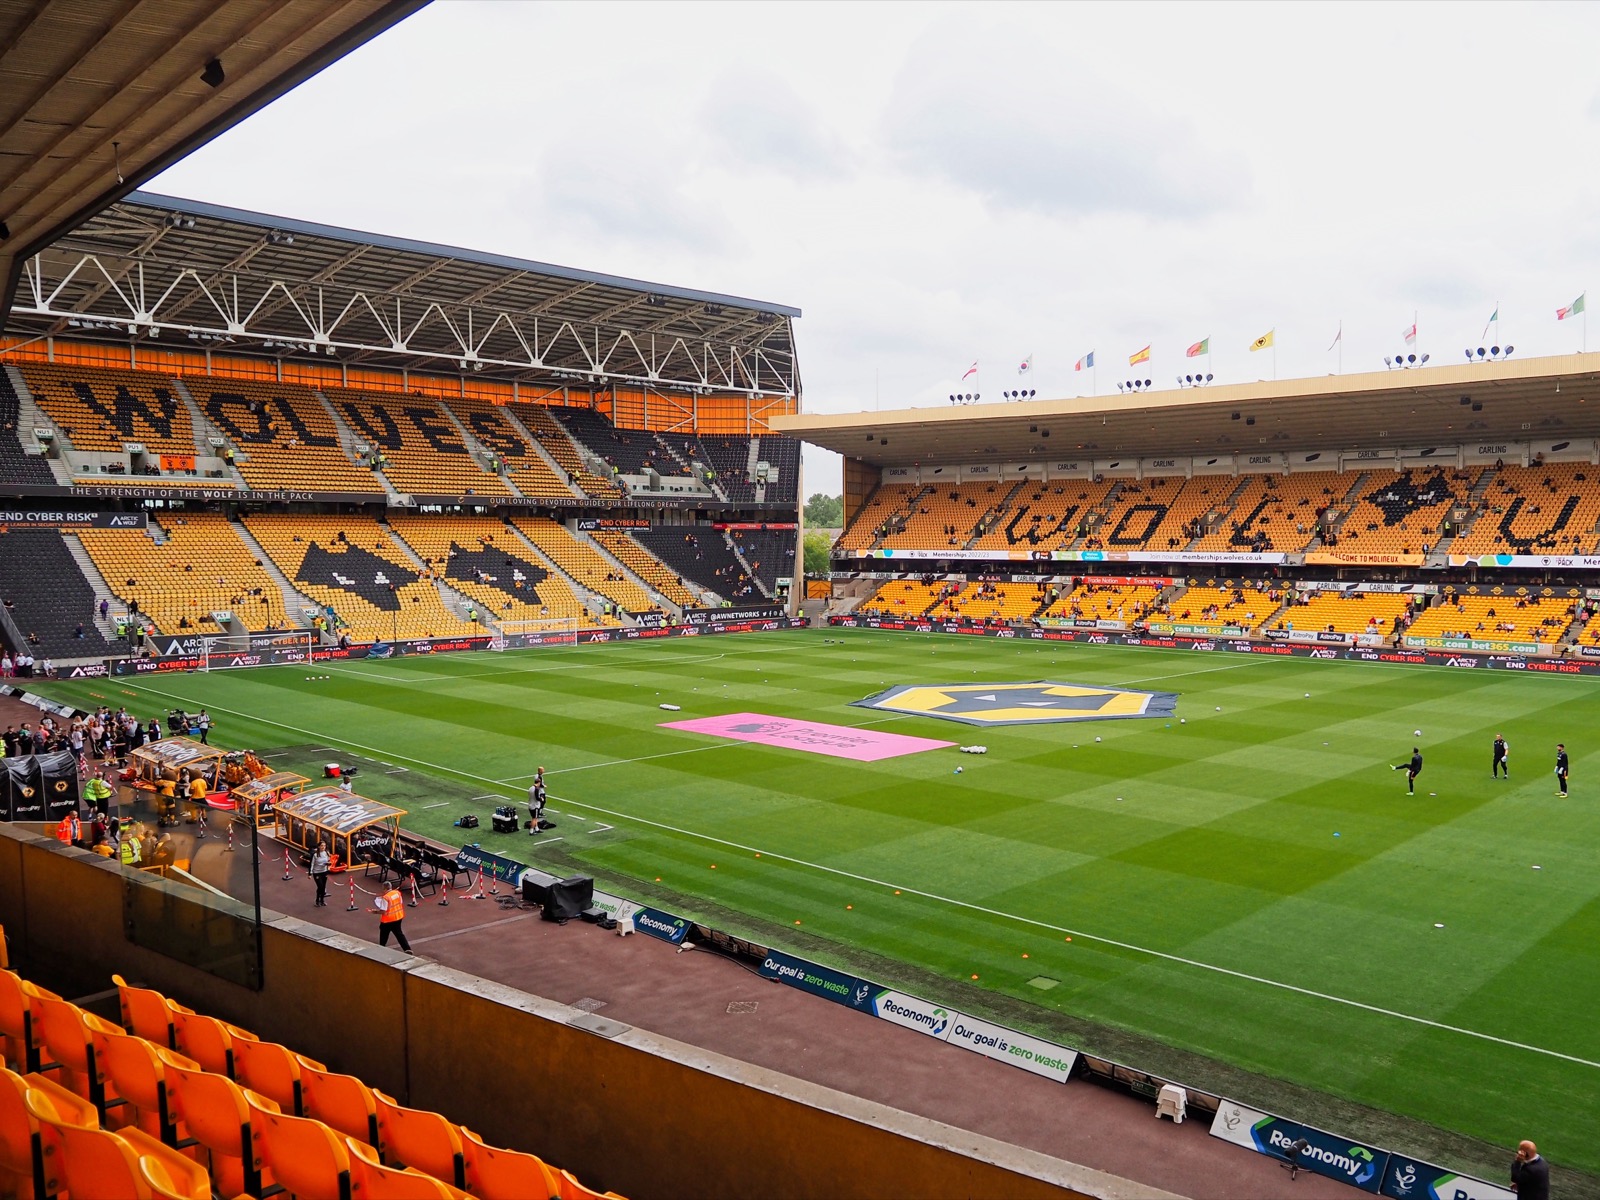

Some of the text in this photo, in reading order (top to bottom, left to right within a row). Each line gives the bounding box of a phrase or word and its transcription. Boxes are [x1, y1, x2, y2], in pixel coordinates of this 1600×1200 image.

[1478, 445, 1506, 454] CARLING
[70, 487, 91, 495] THE
[96, 488, 155, 496] STRENGTH
[0, 512, 23, 521] END
[26, 513, 64, 521] CYBER
[1330, 552, 1398, 563] WELCOME TO MOLINEUX
[710, 611, 760, 621] @AWNETWORKS
[1194, 626, 1241, 636] bet365.com
[183, 638, 217, 647] ARCTIC
[1407, 637, 1536, 652] bet365.com bet365.com
[1558, 664, 1579, 672] RISK
[770, 732, 856, 748] League
[794, 728, 880, 745] Premier
[295, 792, 376, 830] AstroPay
[356, 837, 389, 848] AstroPay
[458, 852, 468, 860] Our
[466, 855, 478, 863] goal
[600, 902, 617, 913] waste
[639, 914, 678, 935] Reconomy
[764, 958, 849, 995] Our goal is zero waste
[883, 999, 939, 1030] Reconomy
[954, 1024, 1068, 1072] Our goal is zero waste
